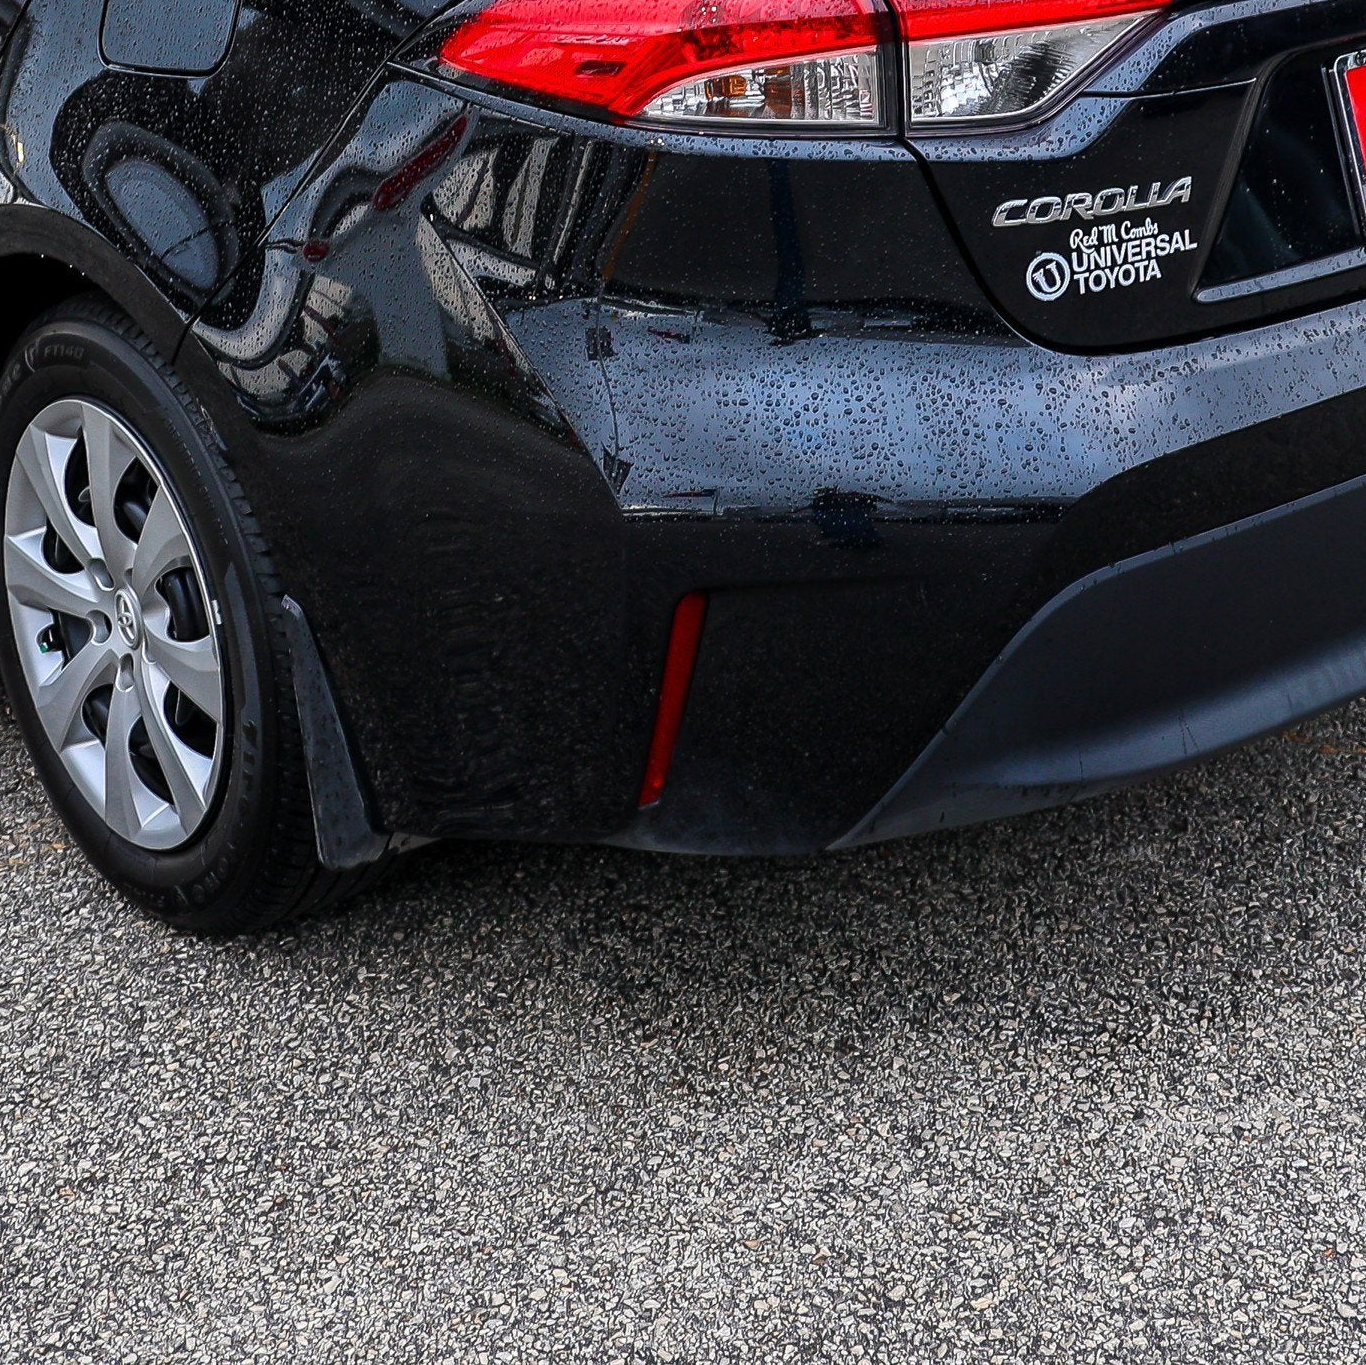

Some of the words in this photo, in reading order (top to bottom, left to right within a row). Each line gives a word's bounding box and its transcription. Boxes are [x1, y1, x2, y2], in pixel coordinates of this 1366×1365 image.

[991, 176, 1192, 227] COROLLA
[1069, 227, 1099, 253] Red
[1071, 229, 1198, 272] UNIVERSAL
[1073, 258, 1162, 295] TOYOTA
